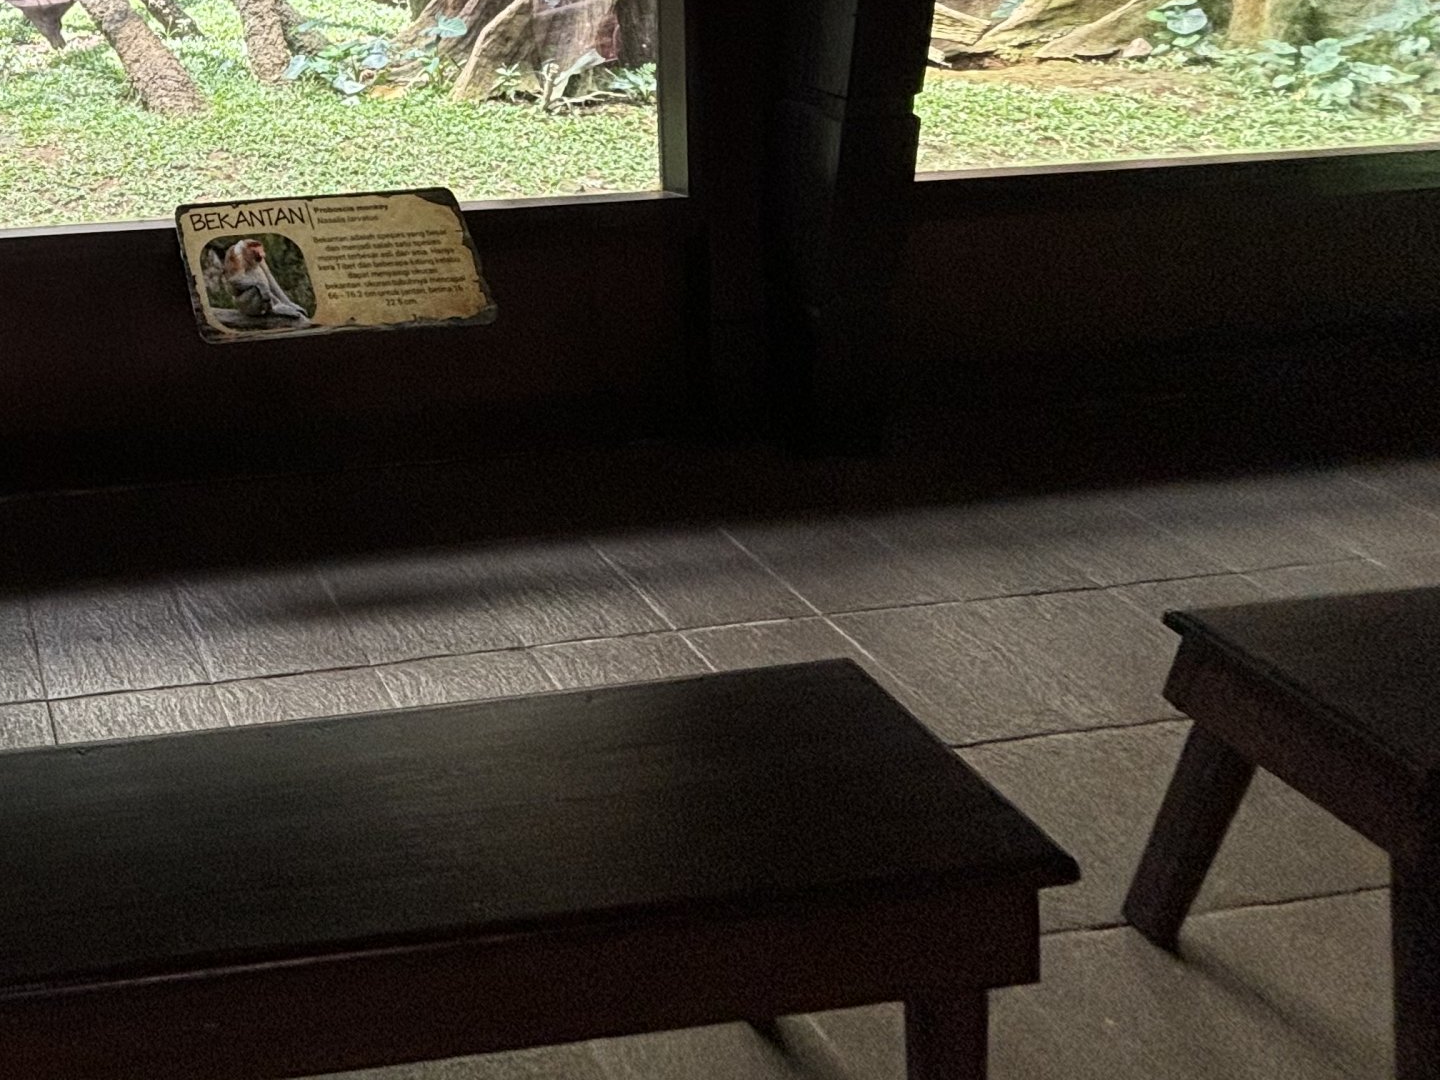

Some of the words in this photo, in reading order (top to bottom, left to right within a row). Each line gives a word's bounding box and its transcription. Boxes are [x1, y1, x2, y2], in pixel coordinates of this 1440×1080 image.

[313, 206, 354, 214] Proboscis
[356, 204, 388, 212] monkey
[189, 207, 305, 232] BEKANTAN
